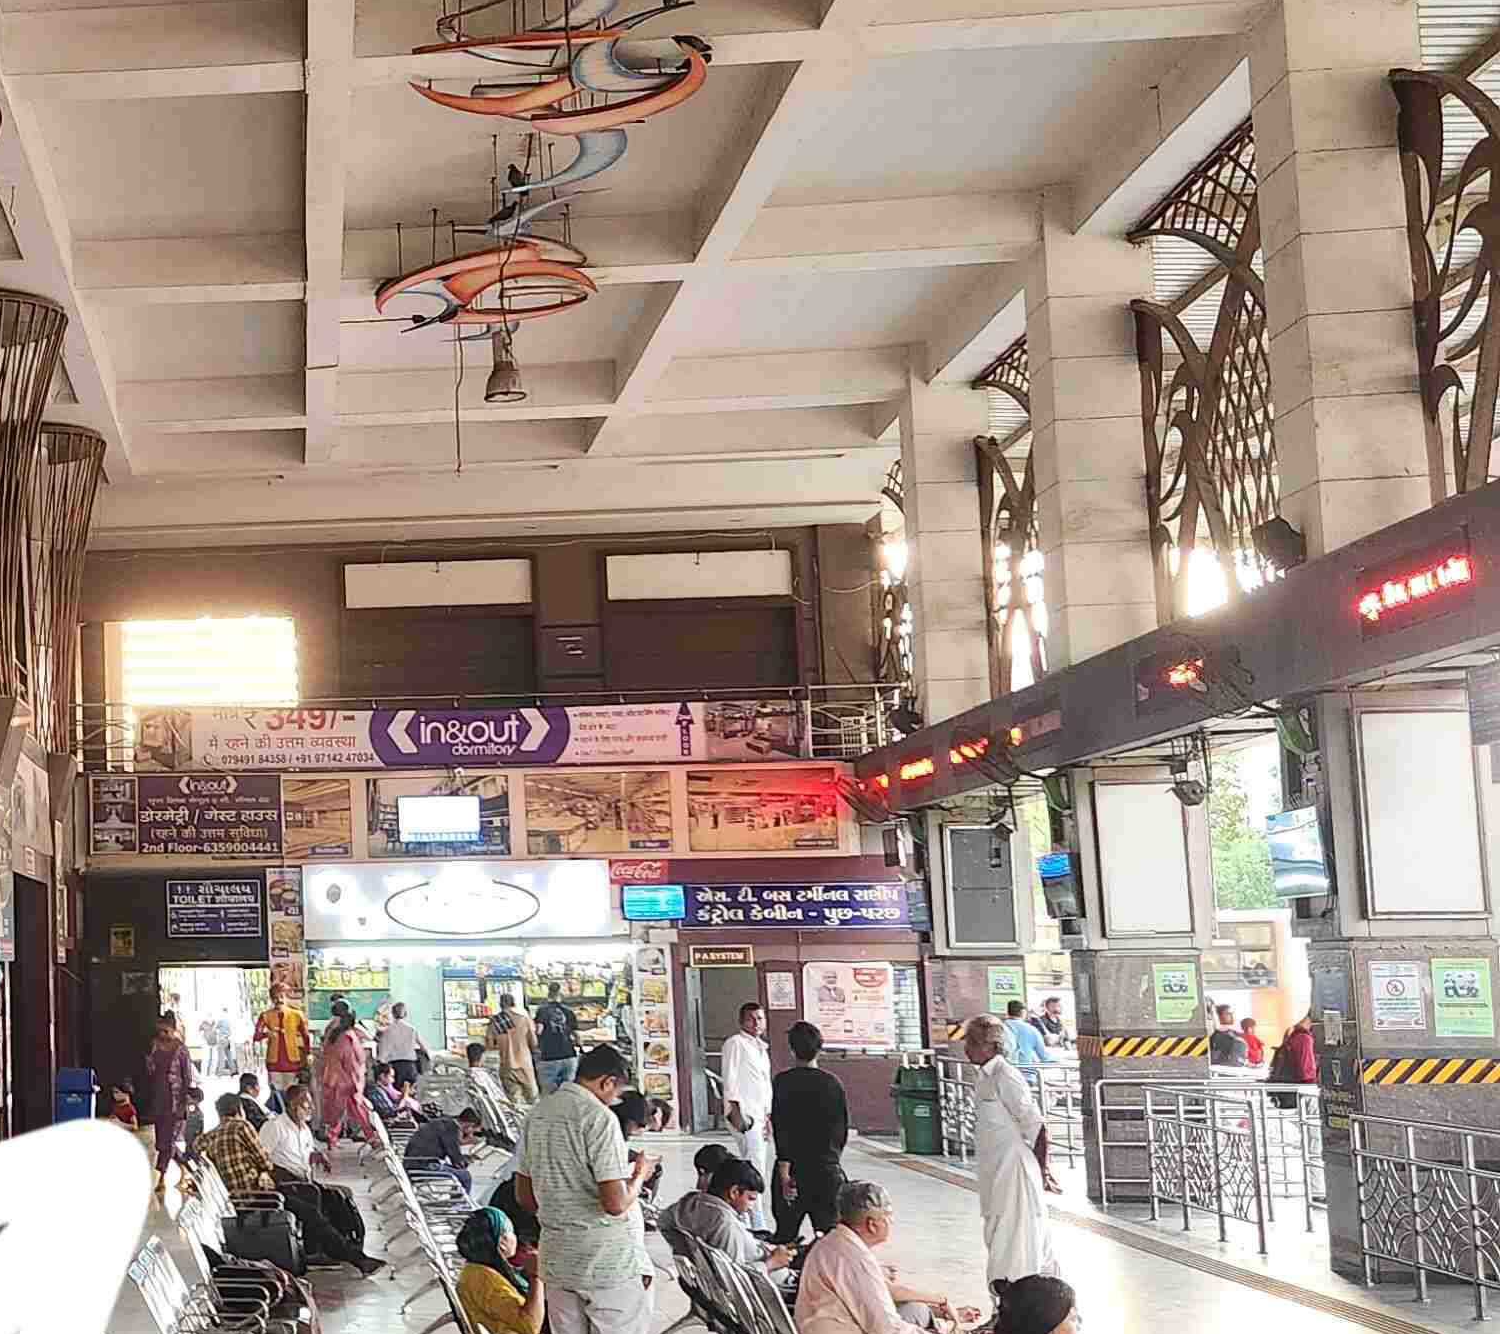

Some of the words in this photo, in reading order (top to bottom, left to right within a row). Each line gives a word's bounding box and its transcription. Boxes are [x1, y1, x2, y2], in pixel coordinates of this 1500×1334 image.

[420, 712, 520, 745] in&out
[255, 733, 272, 749] की
[451, 741, 517, 756] dormitory
[141, 842, 164, 853] 2nd
[172, 894, 212, 904] TOILET
[762, 889, 792, 902] બસ
